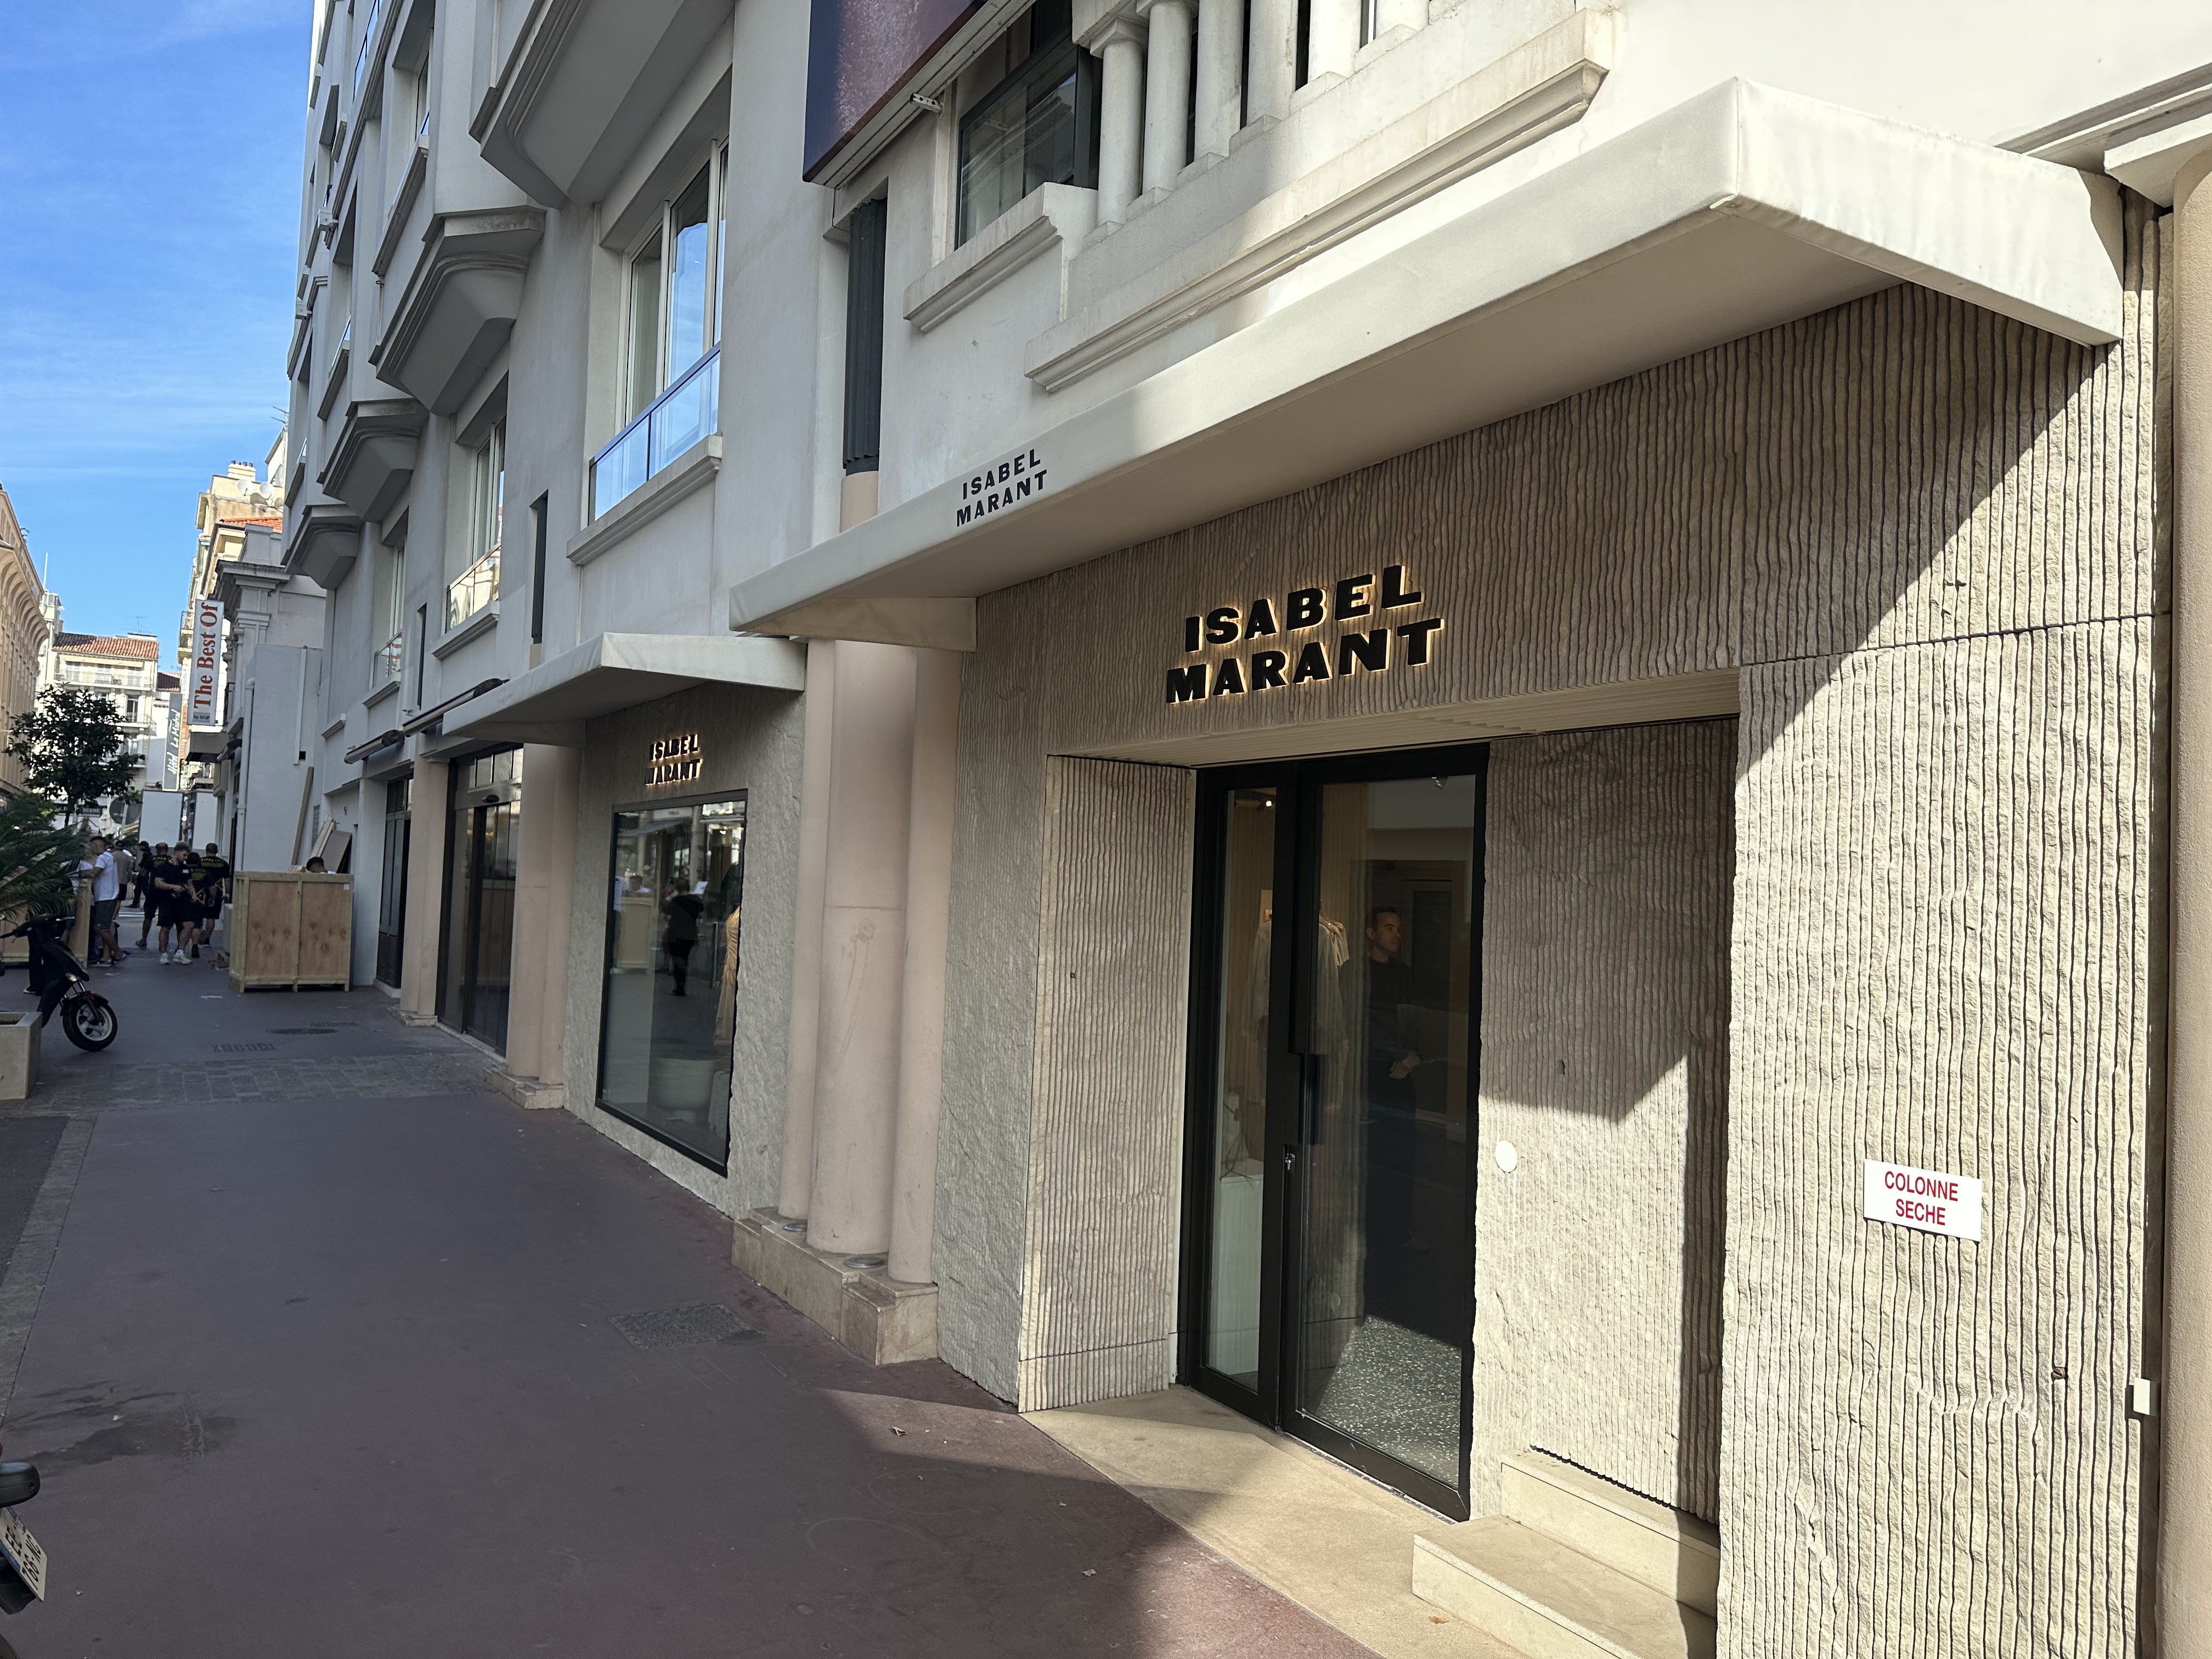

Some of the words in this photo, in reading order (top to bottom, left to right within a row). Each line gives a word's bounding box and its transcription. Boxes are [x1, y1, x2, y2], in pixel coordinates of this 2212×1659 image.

[963, 449, 1041, 500] ISABEL
[957, 469, 1047, 527] MARANT
[200, 602, 218, 627] Of
[1185, 565, 1425, 652] ISABEL
[196, 631, 216, 670] Best
[1166, 618, 1444, 703] MARANT
[194, 675, 213, 708] The
[649, 734, 699, 761] ISABEL
[645, 758, 702, 785] MARANT
[1885, 1171, 1958, 1201] COLONNE
[1895, 1199, 1945, 1226] SECHE
